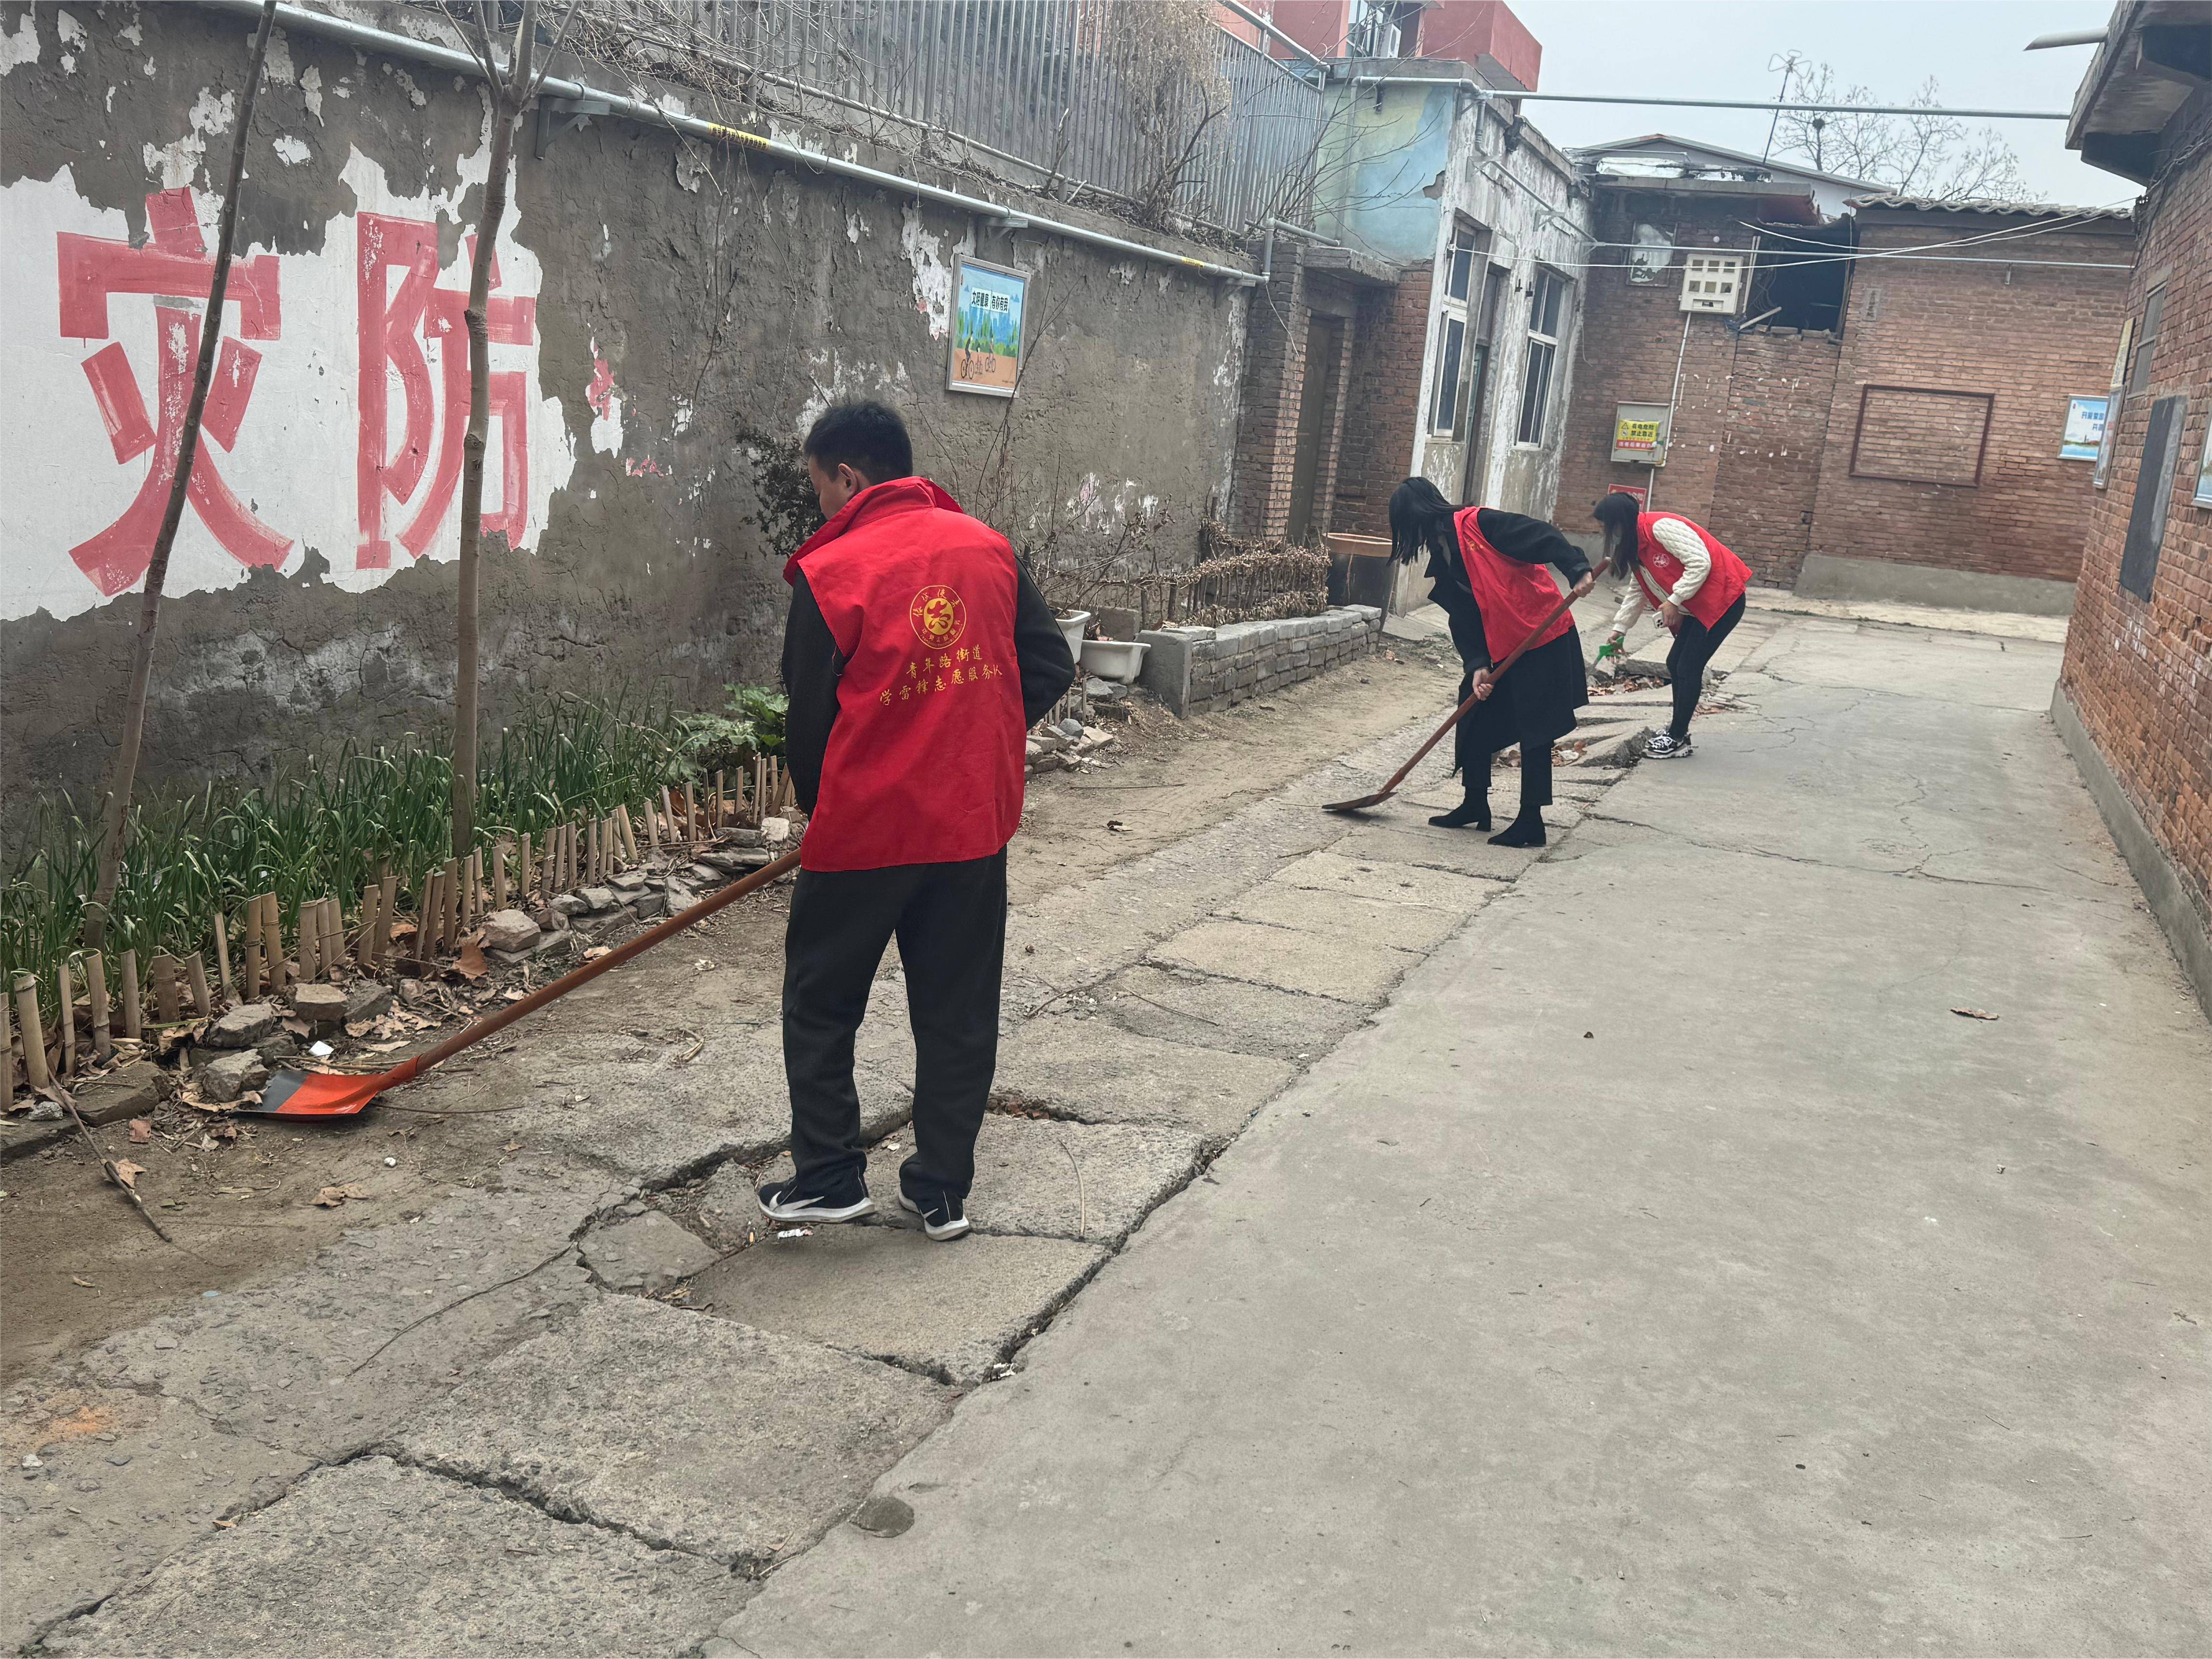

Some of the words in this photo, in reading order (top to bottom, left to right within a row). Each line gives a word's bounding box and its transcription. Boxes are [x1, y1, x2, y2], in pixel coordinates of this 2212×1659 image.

[972, 290, 989, 307] 文明健康
[992, 295, 1008, 311] 有你有我
[906, 644, 983, 679] 青年路街道
[880, 664, 1003, 706] 学雷锋志愿服务队
